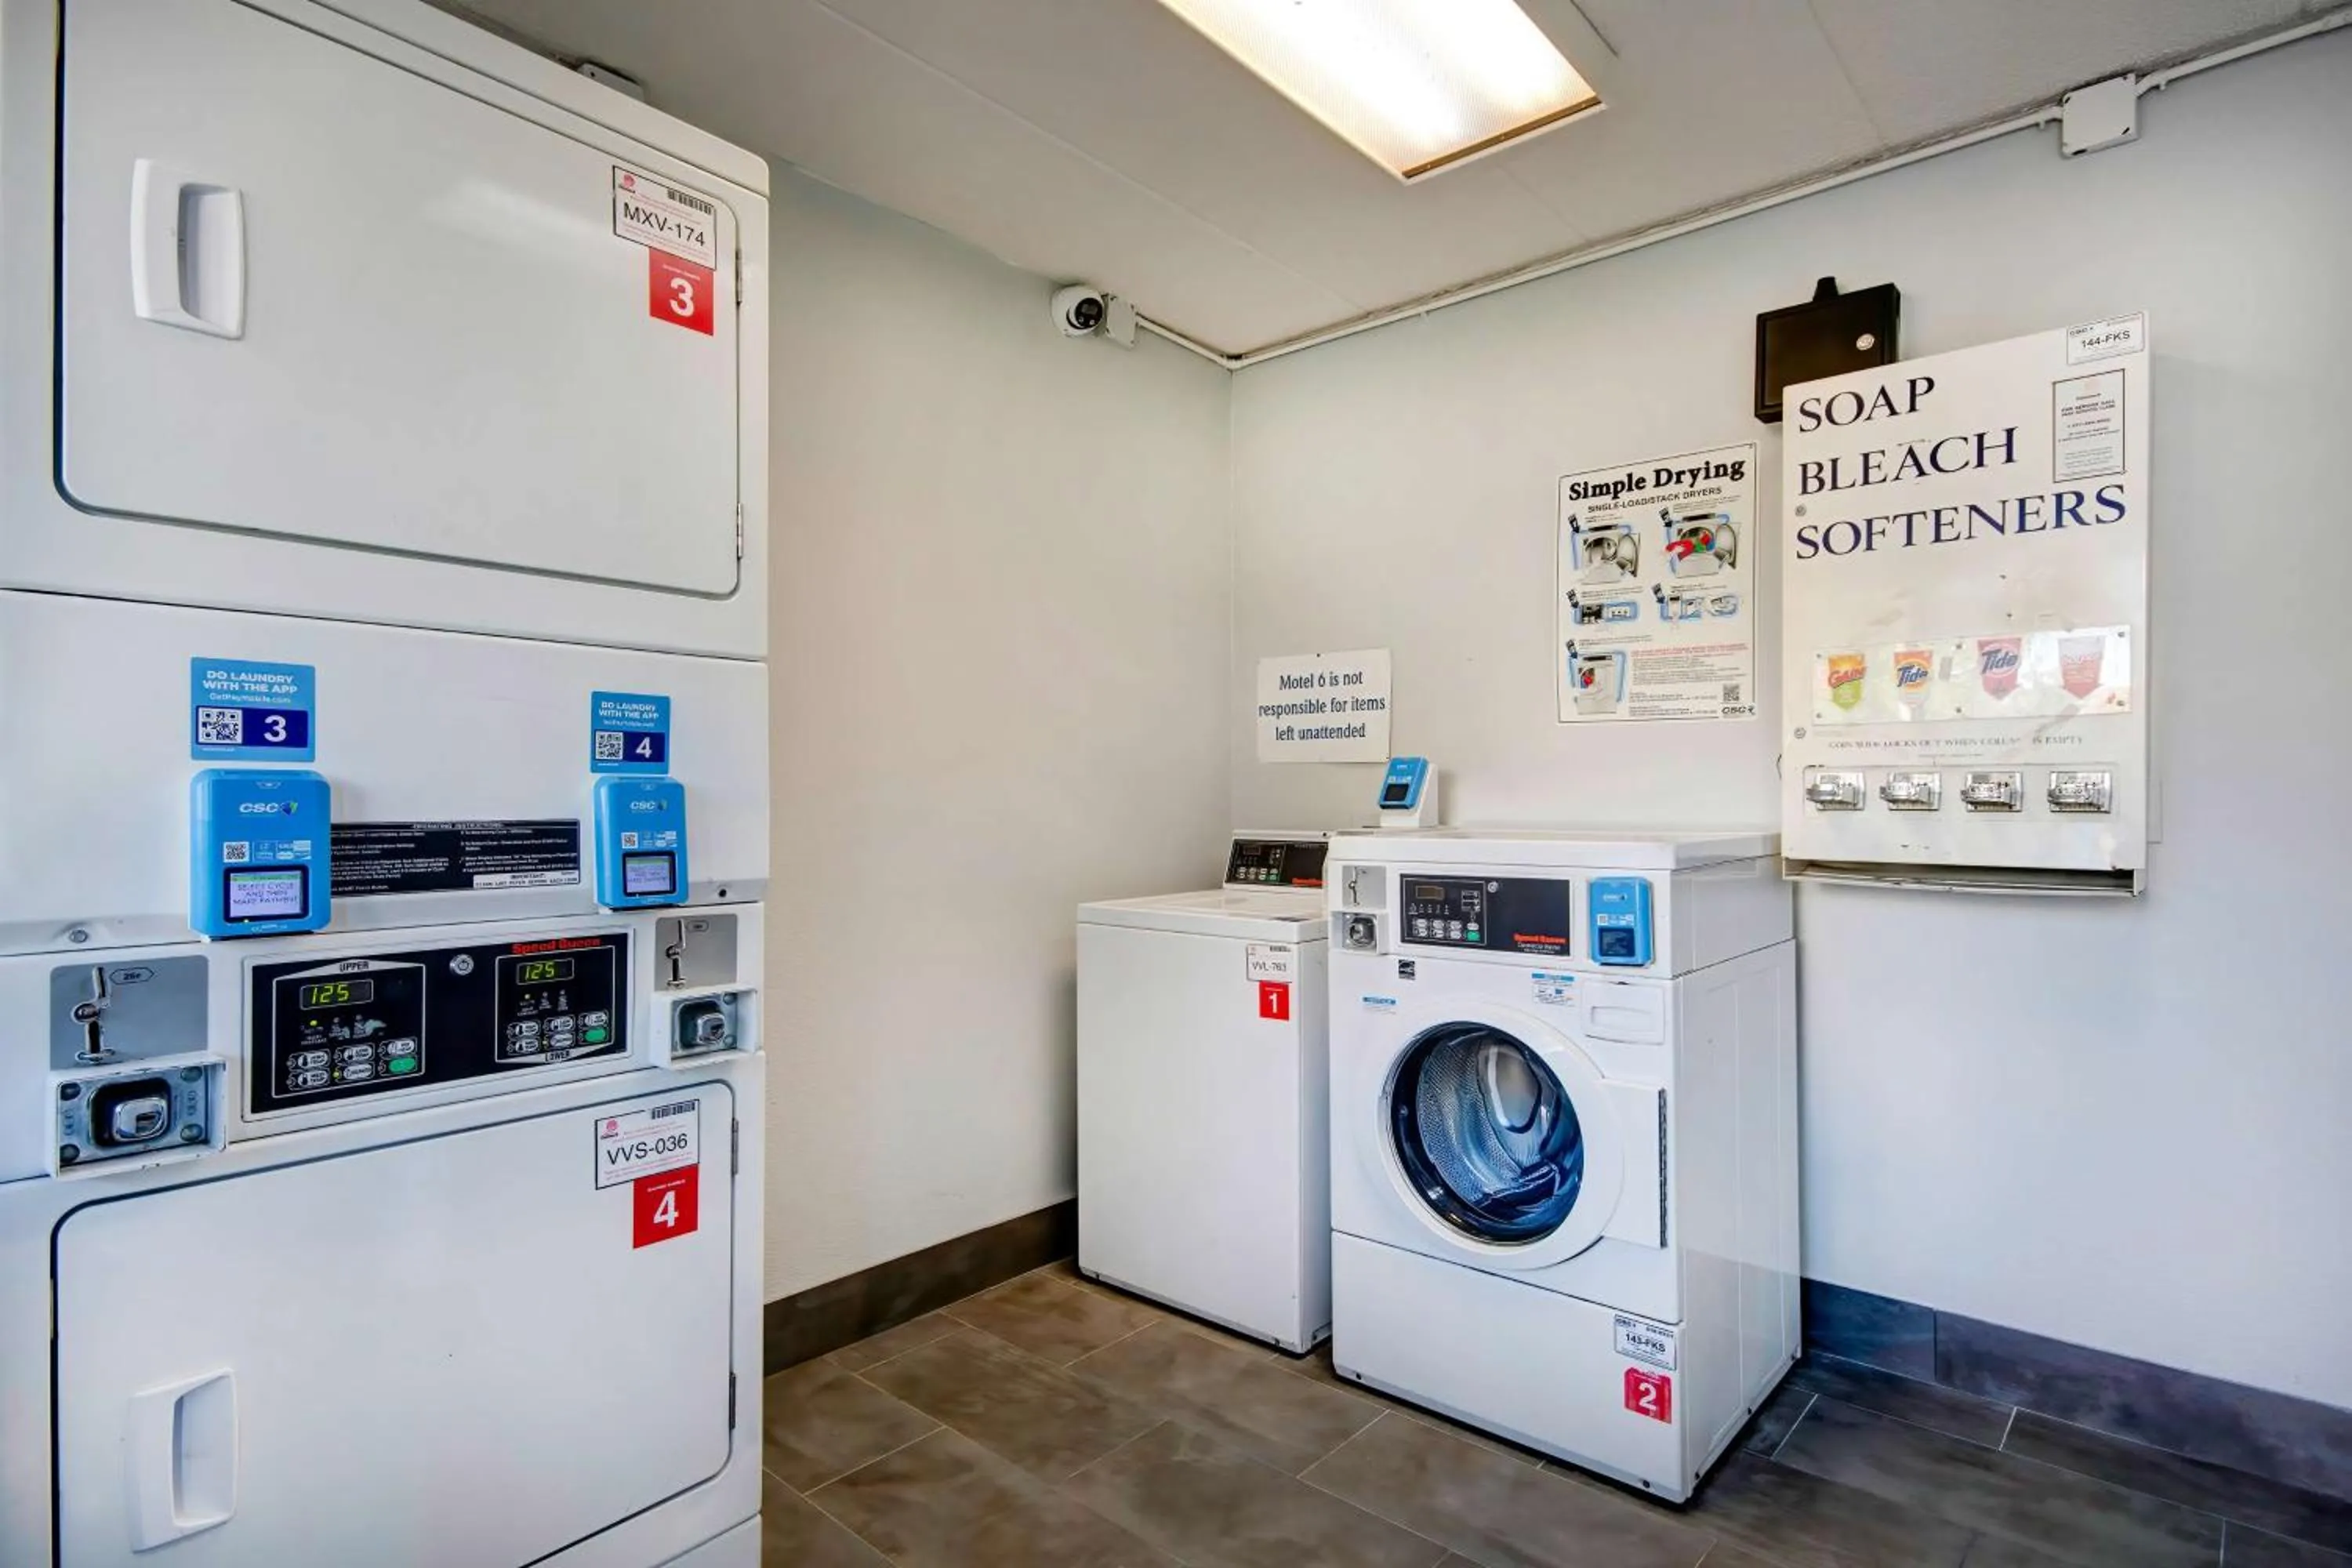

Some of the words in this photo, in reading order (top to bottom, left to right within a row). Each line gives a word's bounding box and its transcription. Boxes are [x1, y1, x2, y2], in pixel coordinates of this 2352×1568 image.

[624, 202, 705, 246] MXV-174
[670, 277, 694, 318] 3
[2082, 330, 2130, 348] 144-FKS
[1798, 376, 1935, 434] SOAP
[1798, 426, 2019, 495] BLEACH
[1569, 472, 1647, 502] Simple
[1653, 459, 1746, 488] Drying
[1682, 486, 1722, 500] DRYERS
[1795, 483, 2127, 560] SOFTENERS
[1981, 648, 2018, 675] Tide
[206, 670, 227, 680] DO
[230, 672, 294, 684] LAUNDRY
[1279, 673, 1314, 691] Motel
[1318, 673, 1326, 688] 6
[1330, 671, 1339, 686] is
[1343, 671, 1363, 685] not
[1896, 664, 1929, 688] Tide
[202, 681, 239, 691] WITH
[243, 683, 269, 692] THE
[272, 684, 298, 694] APP
[598, 709, 622, 717] WITH
[616, 702, 656, 712] LAUNDRY
[1258, 699, 1327, 720] responsible
[1330, 697, 1348, 713] for
[1351, 696, 1386, 711] items
[263, 714, 287, 742] 3
[1276, 726, 1294, 741] left
[1298, 723, 1366, 740] unattended
[636, 736, 652, 758] 4
[239, 803, 278, 815] CSC
[630, 800, 655, 810] CSC
[512, 940, 557, 955] Speed
[558, 938, 601, 949] Queen
[339, 960, 370, 973] UPPER
[524, 961, 555, 980] 125
[311, 982, 350, 1004] 125
[1269, 992, 1278, 1014] 1
[544, 1050, 571, 1062] LOWER
[607, 1133, 688, 1165] VVS-036
[653, 1190, 679, 1229] 4
[1639, 1382, 1657, 1411] 2
